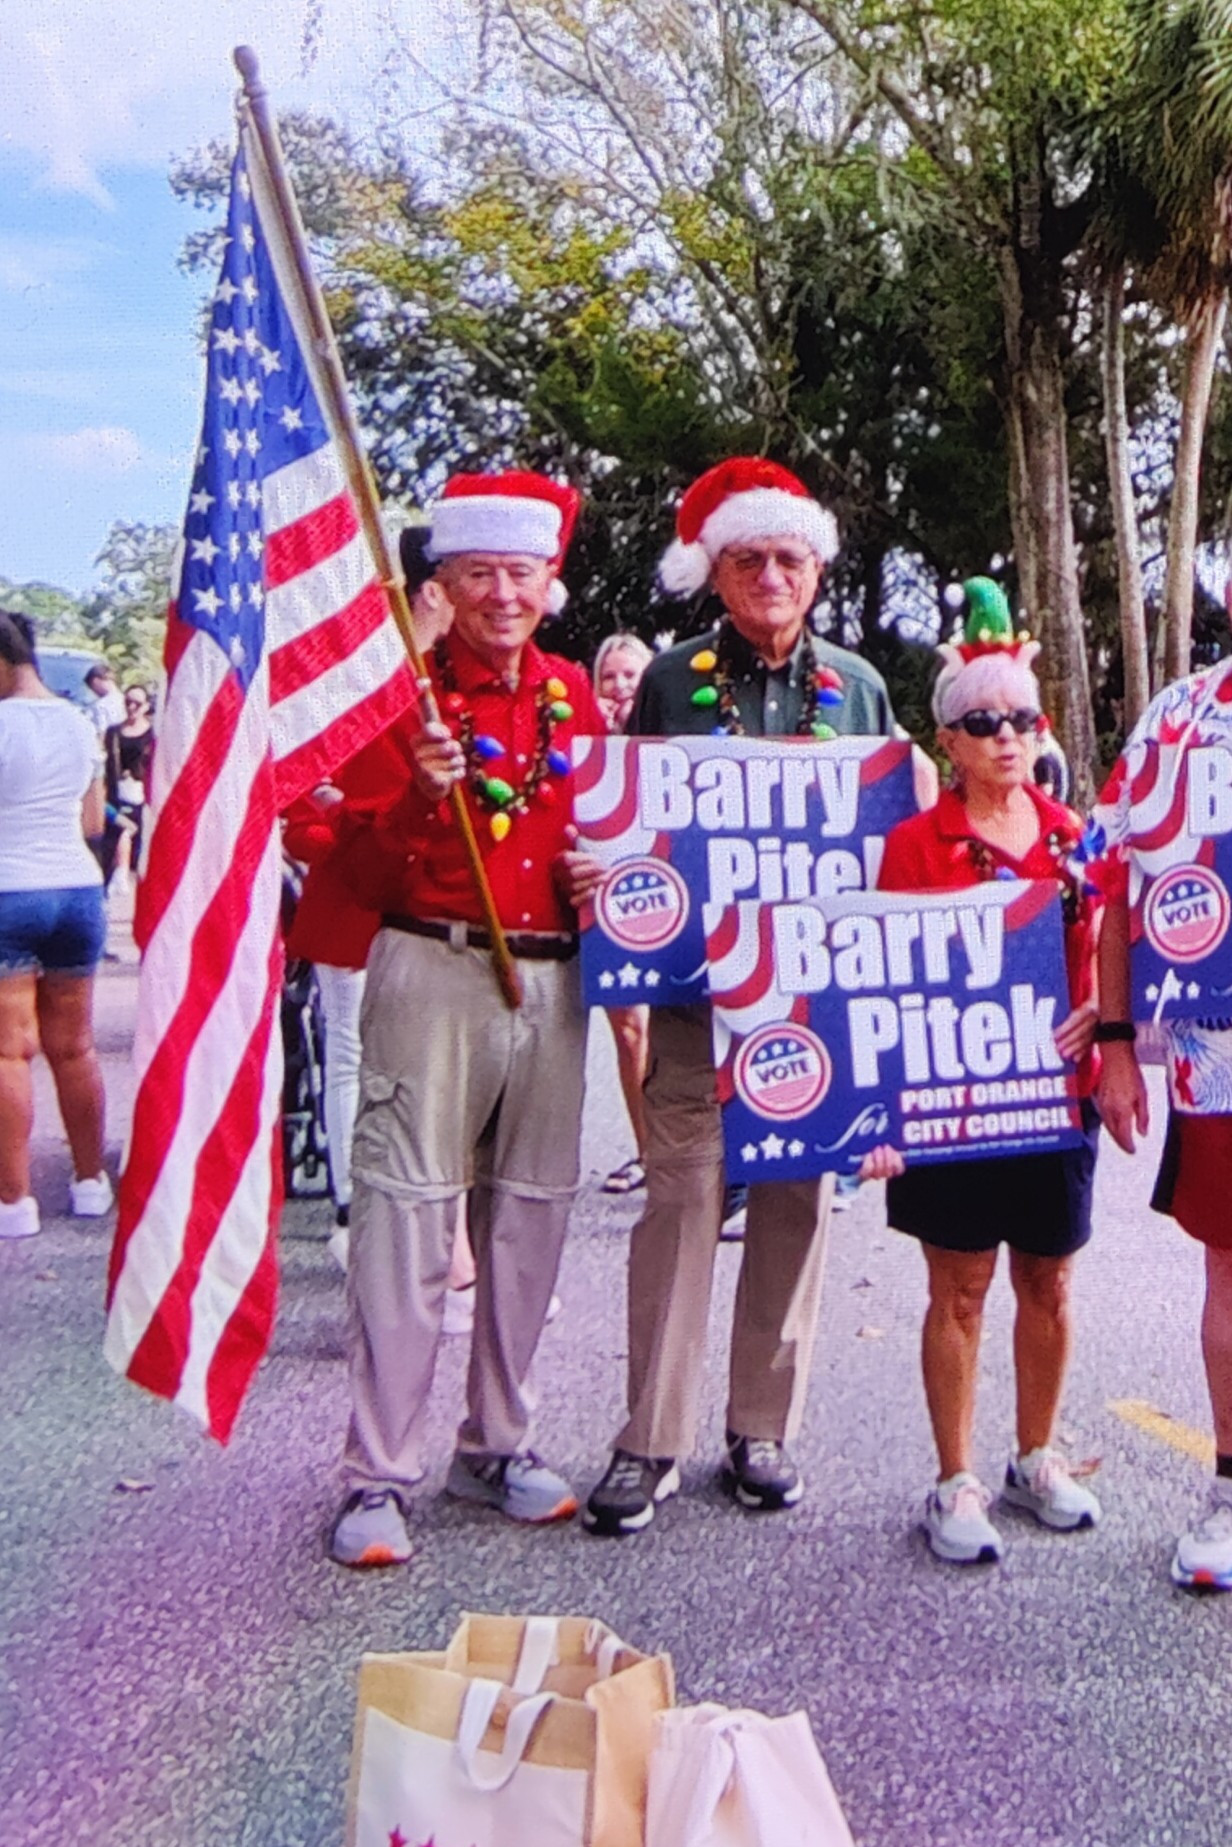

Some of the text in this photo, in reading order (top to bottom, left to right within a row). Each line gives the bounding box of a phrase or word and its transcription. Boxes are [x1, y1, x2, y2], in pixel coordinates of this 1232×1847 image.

[638, 742, 861, 836] Barry
[615, 891, 668, 915] VOTE
[1162, 900, 1210, 927] VOTE
[772, 903, 1004, 992] Barry
[848, 984, 1063, 1088] Pitek
[755, 1057, 809, 1084] VOTE
[901, 1076, 1066, 1113] PORT ORANGE
[816, 1103, 889, 1153] for
[903, 1107, 1072, 1144] CITY COUNCIL
